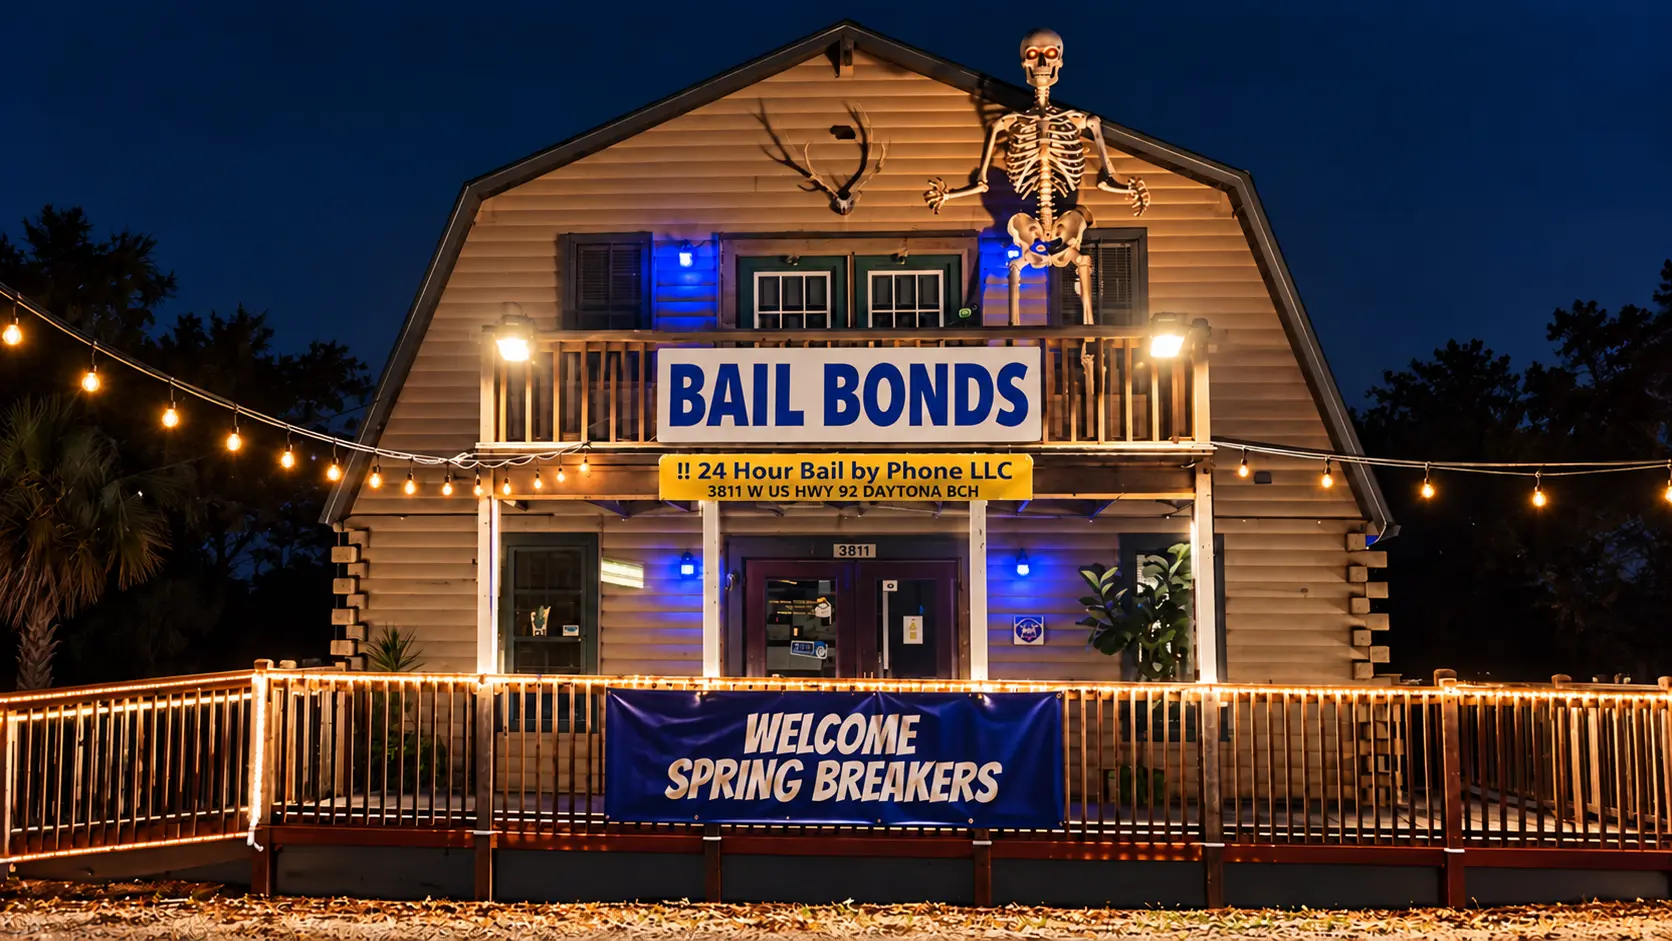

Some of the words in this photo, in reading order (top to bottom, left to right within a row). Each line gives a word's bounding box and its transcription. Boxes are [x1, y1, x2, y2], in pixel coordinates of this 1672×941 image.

[669, 363, 804, 427] BAIL
[823, 362, 1029, 427] BONDS
[698, 462, 727, 480] 24
[734, 462, 794, 480] Hour
[800, 461, 844, 480] Bail
[851, 461, 880, 484] by
[887, 461, 963, 480] Phone
[970, 462, 1013, 480] LLC
[707, 485, 742, 498] 3811
[748, 485, 764, 498] W
[768, 485, 790, 498] US
[795, 485, 833, 498] HWY
[839, 485, 858, 498] 92
[863, 485, 942, 498] DAYTONA
[947, 485, 979, 498] BCH
[838, 545, 870, 557] 3811
[743, 712, 921, 755] WELCOME
[664, 758, 804, 803] SPRING
[811, 760, 1003, 804] BREAKERS
